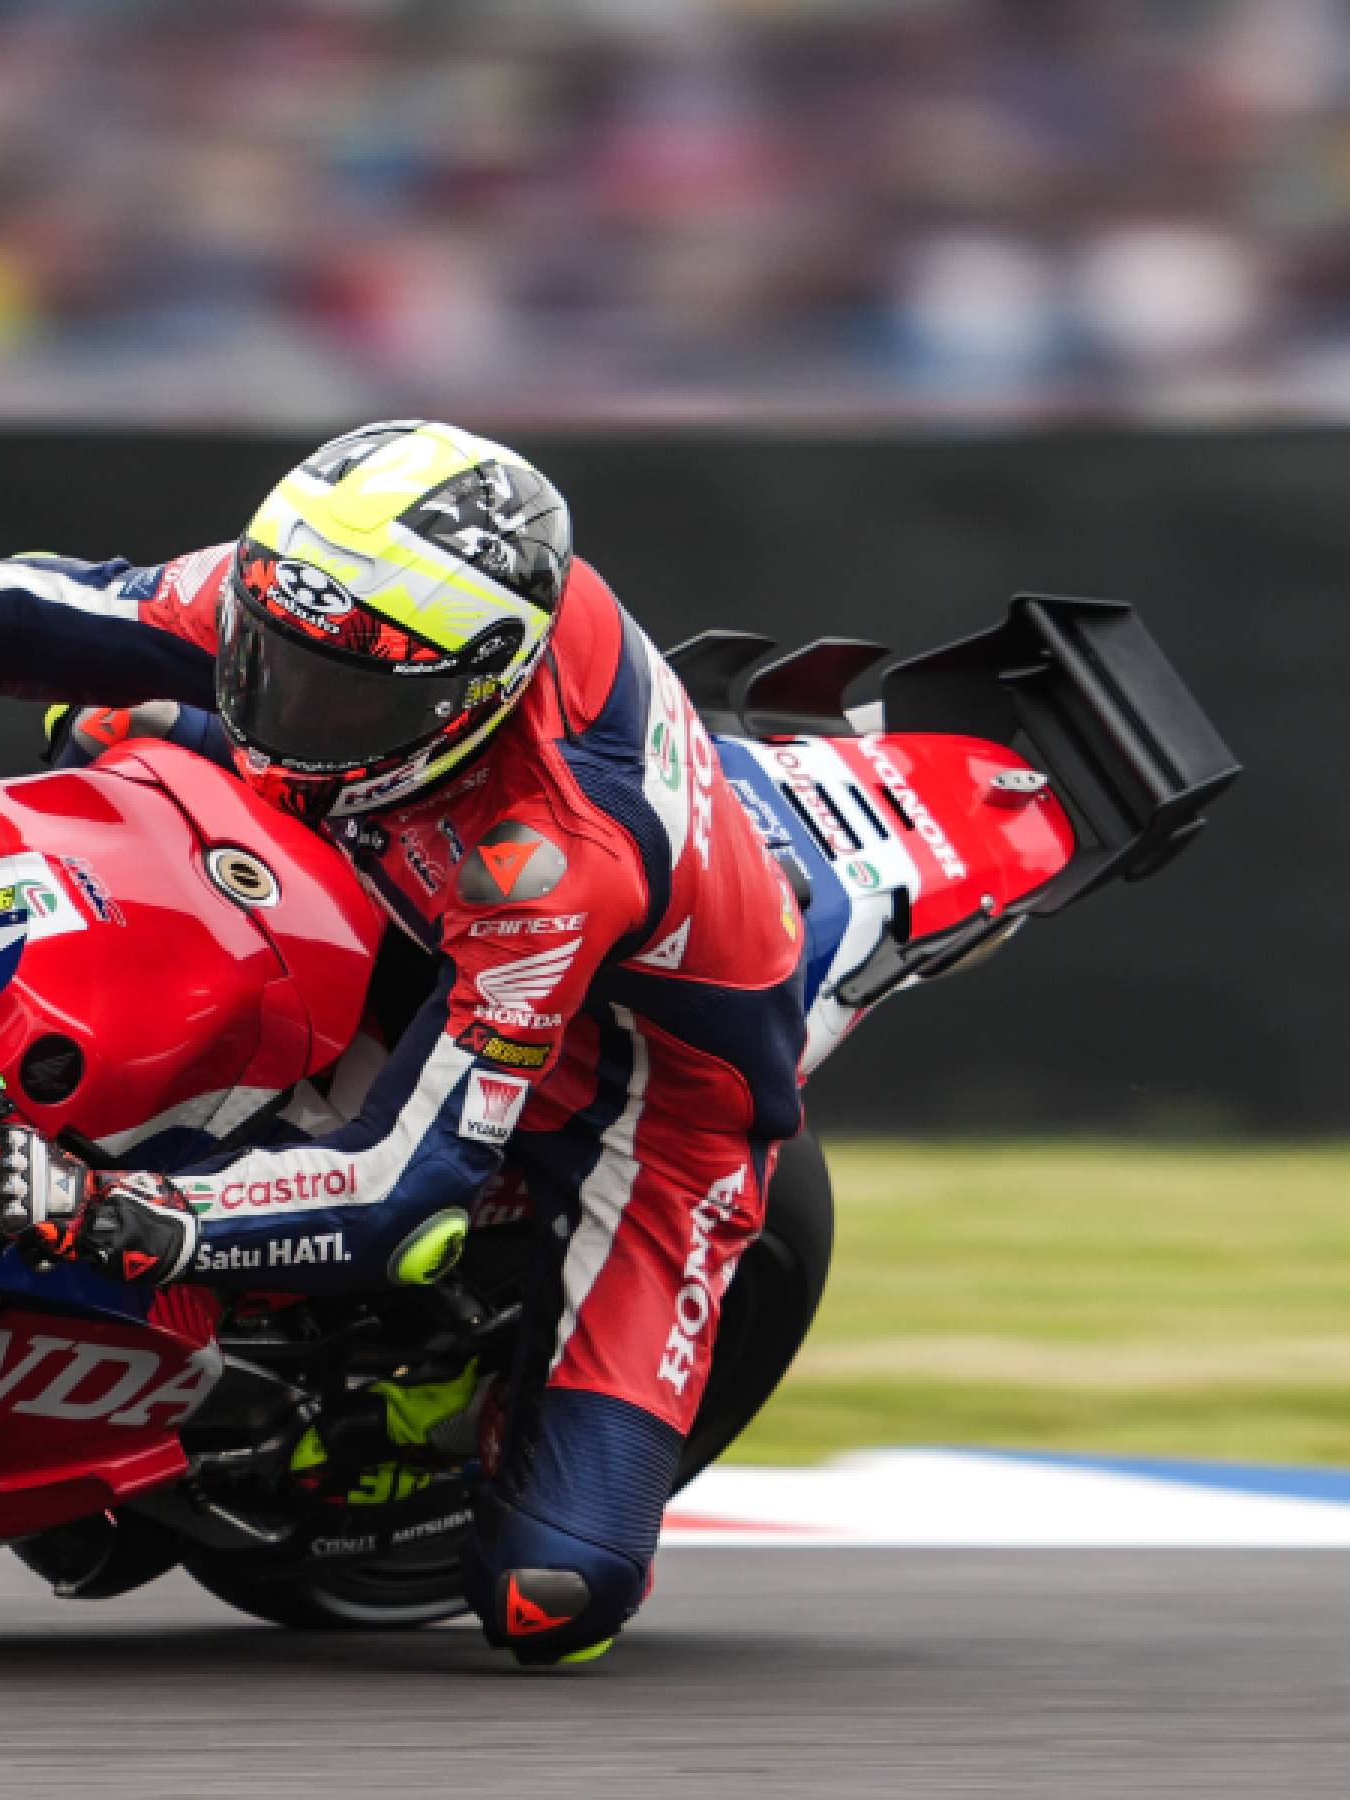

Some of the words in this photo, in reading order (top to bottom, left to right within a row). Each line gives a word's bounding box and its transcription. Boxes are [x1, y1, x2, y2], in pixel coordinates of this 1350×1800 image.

[473, 1004, 562, 1029] HONDA
[220, 1163, 358, 1210] Castrol
[195, 1242, 262, 1272] Satu
[268, 1232, 352, 1266] HATI.
[656, 1163, 748, 1396] HONDA
